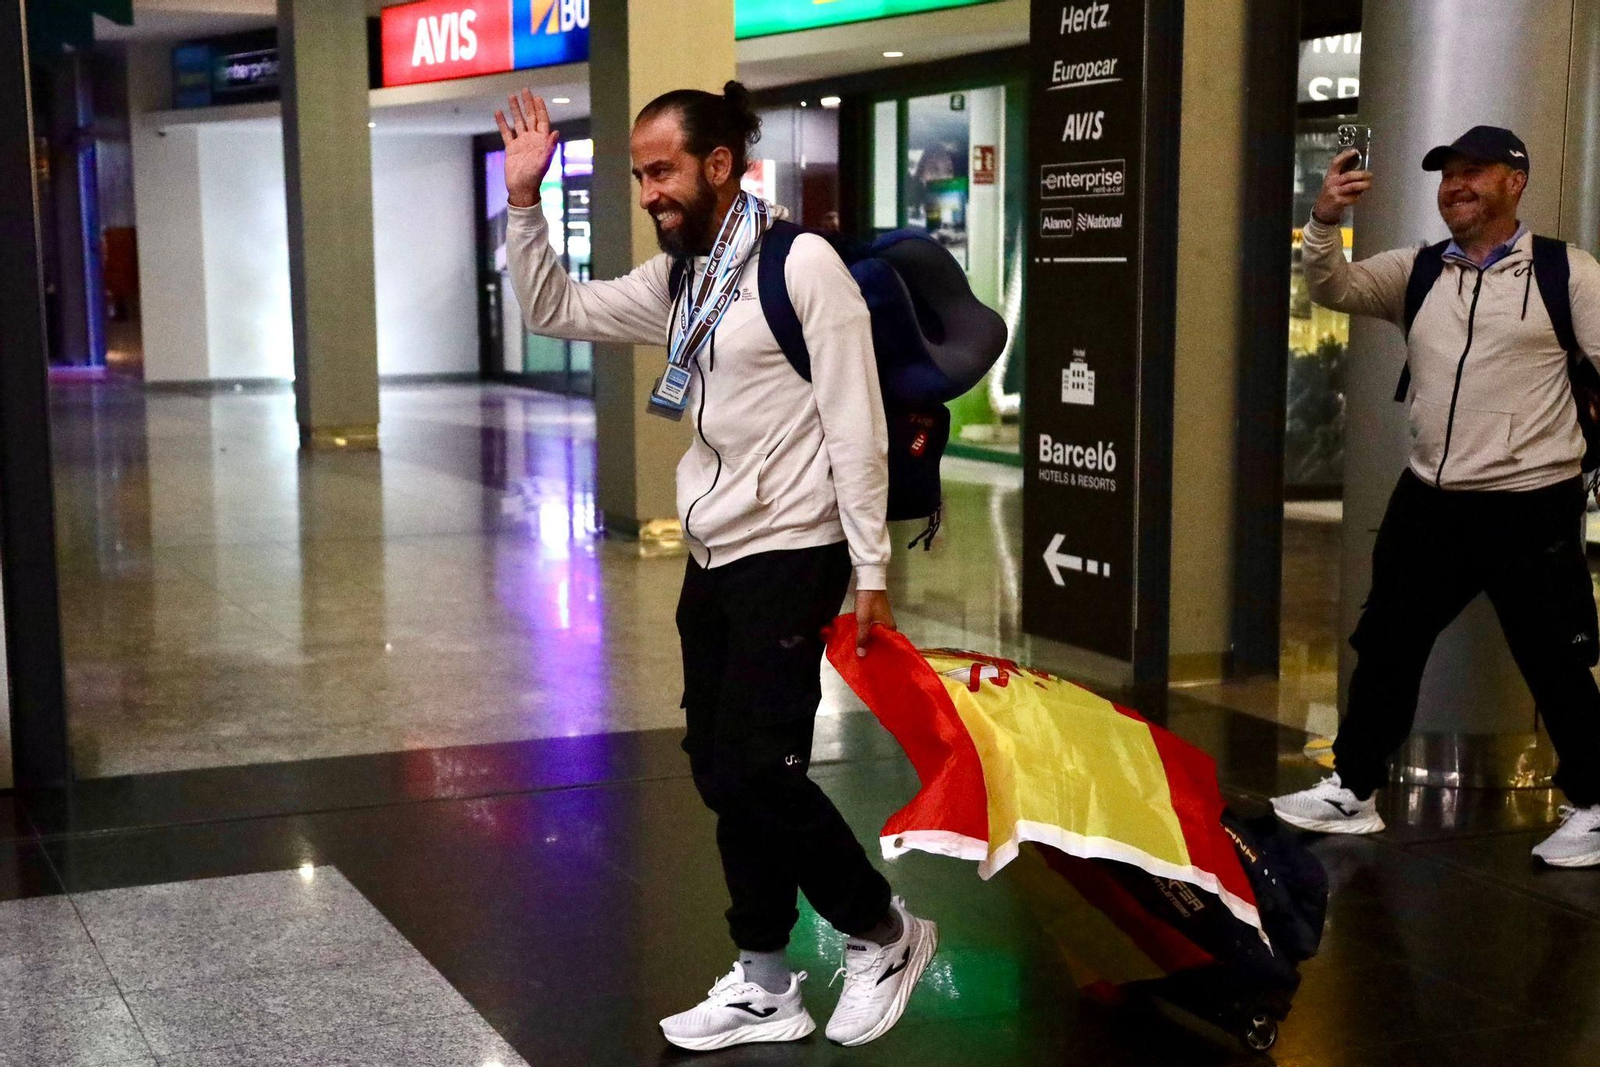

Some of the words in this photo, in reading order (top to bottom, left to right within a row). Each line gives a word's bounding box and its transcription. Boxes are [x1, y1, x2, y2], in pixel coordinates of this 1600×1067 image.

[1060, 2, 1109, 35] Hertz
[412, 9, 477, 66] AVIS
[1052, 58, 1118, 83] Europcar
[1062, 110, 1105, 142] AVIS
[1046, 167, 1123, 191] enterprise
[1042, 216, 1072, 229] Alamo
[1086, 213, 1123, 229] National
[1039, 433, 1116, 472] Barceló
[1039, 469, 1069, 484] HOTELS
[1071, 473, 1076, 486] &
[1077, 474, 1116, 492] RESORTS
